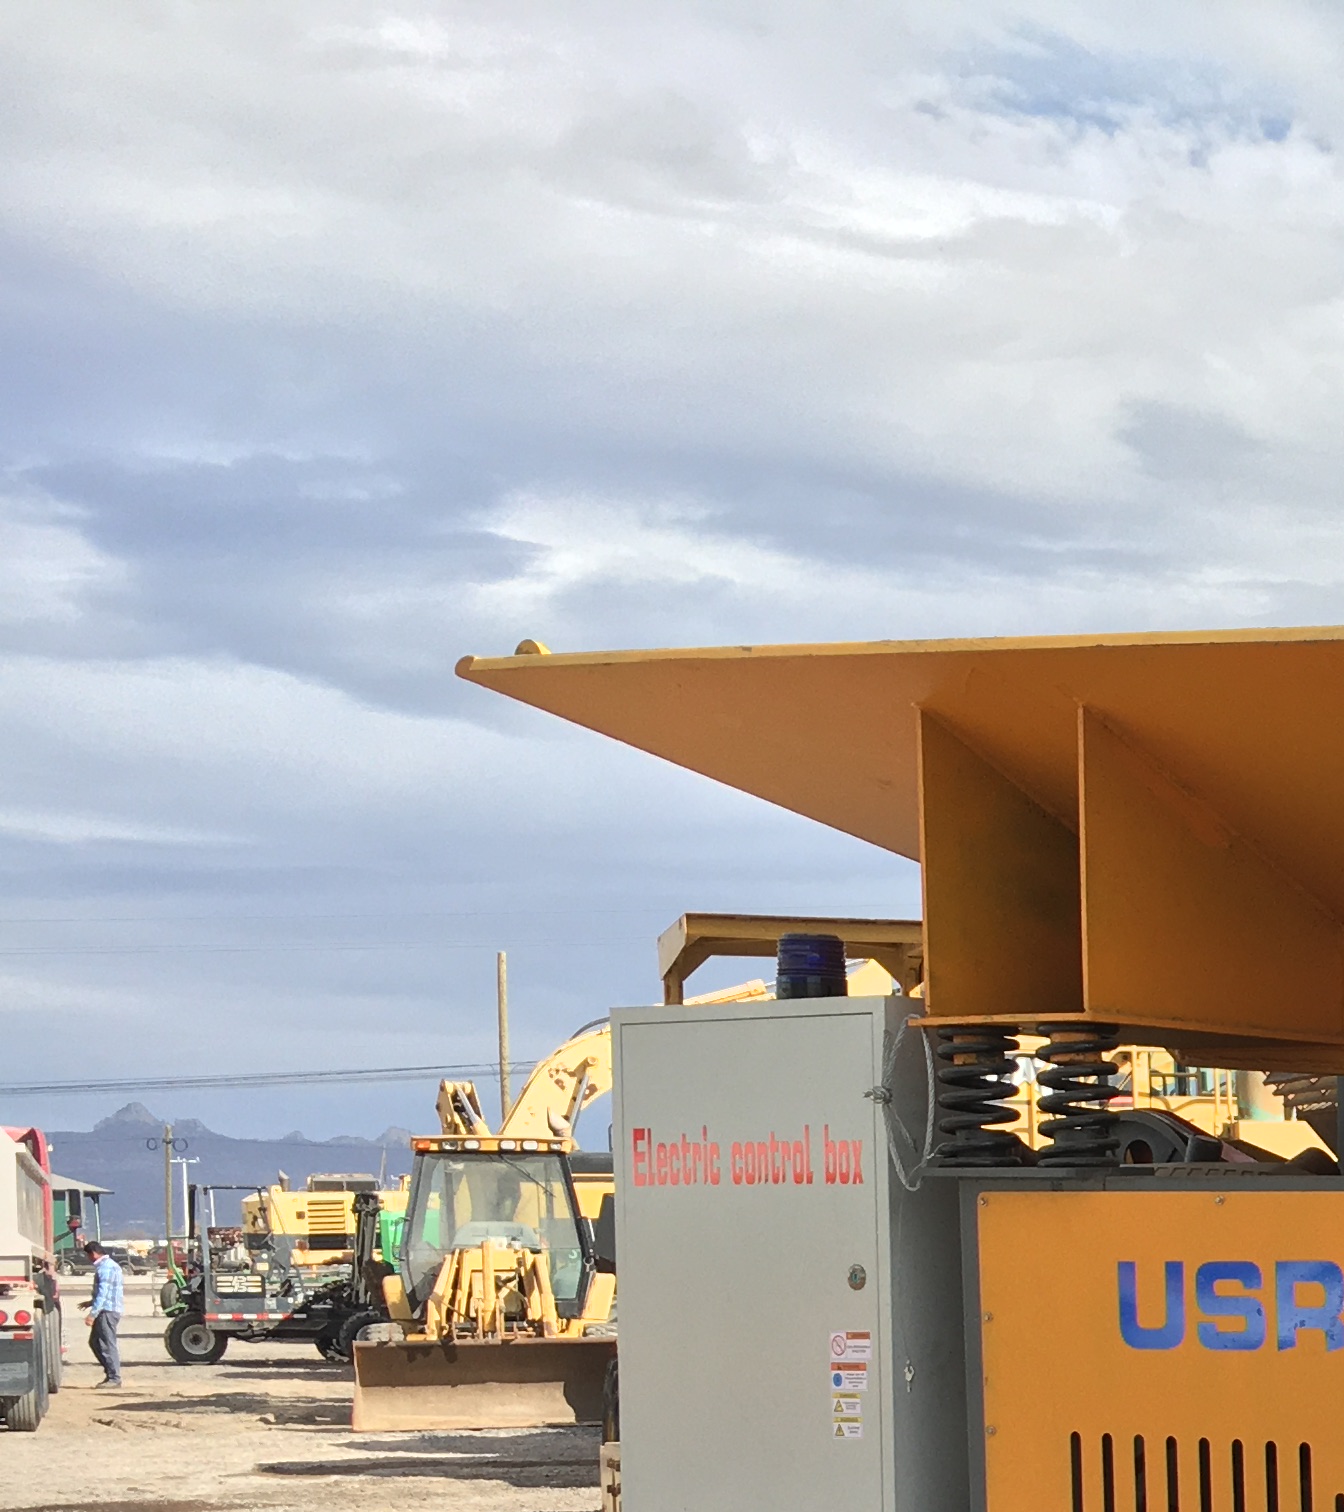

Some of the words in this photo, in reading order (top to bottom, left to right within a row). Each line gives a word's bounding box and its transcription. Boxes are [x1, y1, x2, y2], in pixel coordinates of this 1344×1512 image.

[632, 1125, 721, 1187] Electric
[731, 1124, 814, 1185] control
[823, 1124, 864, 1185] box
